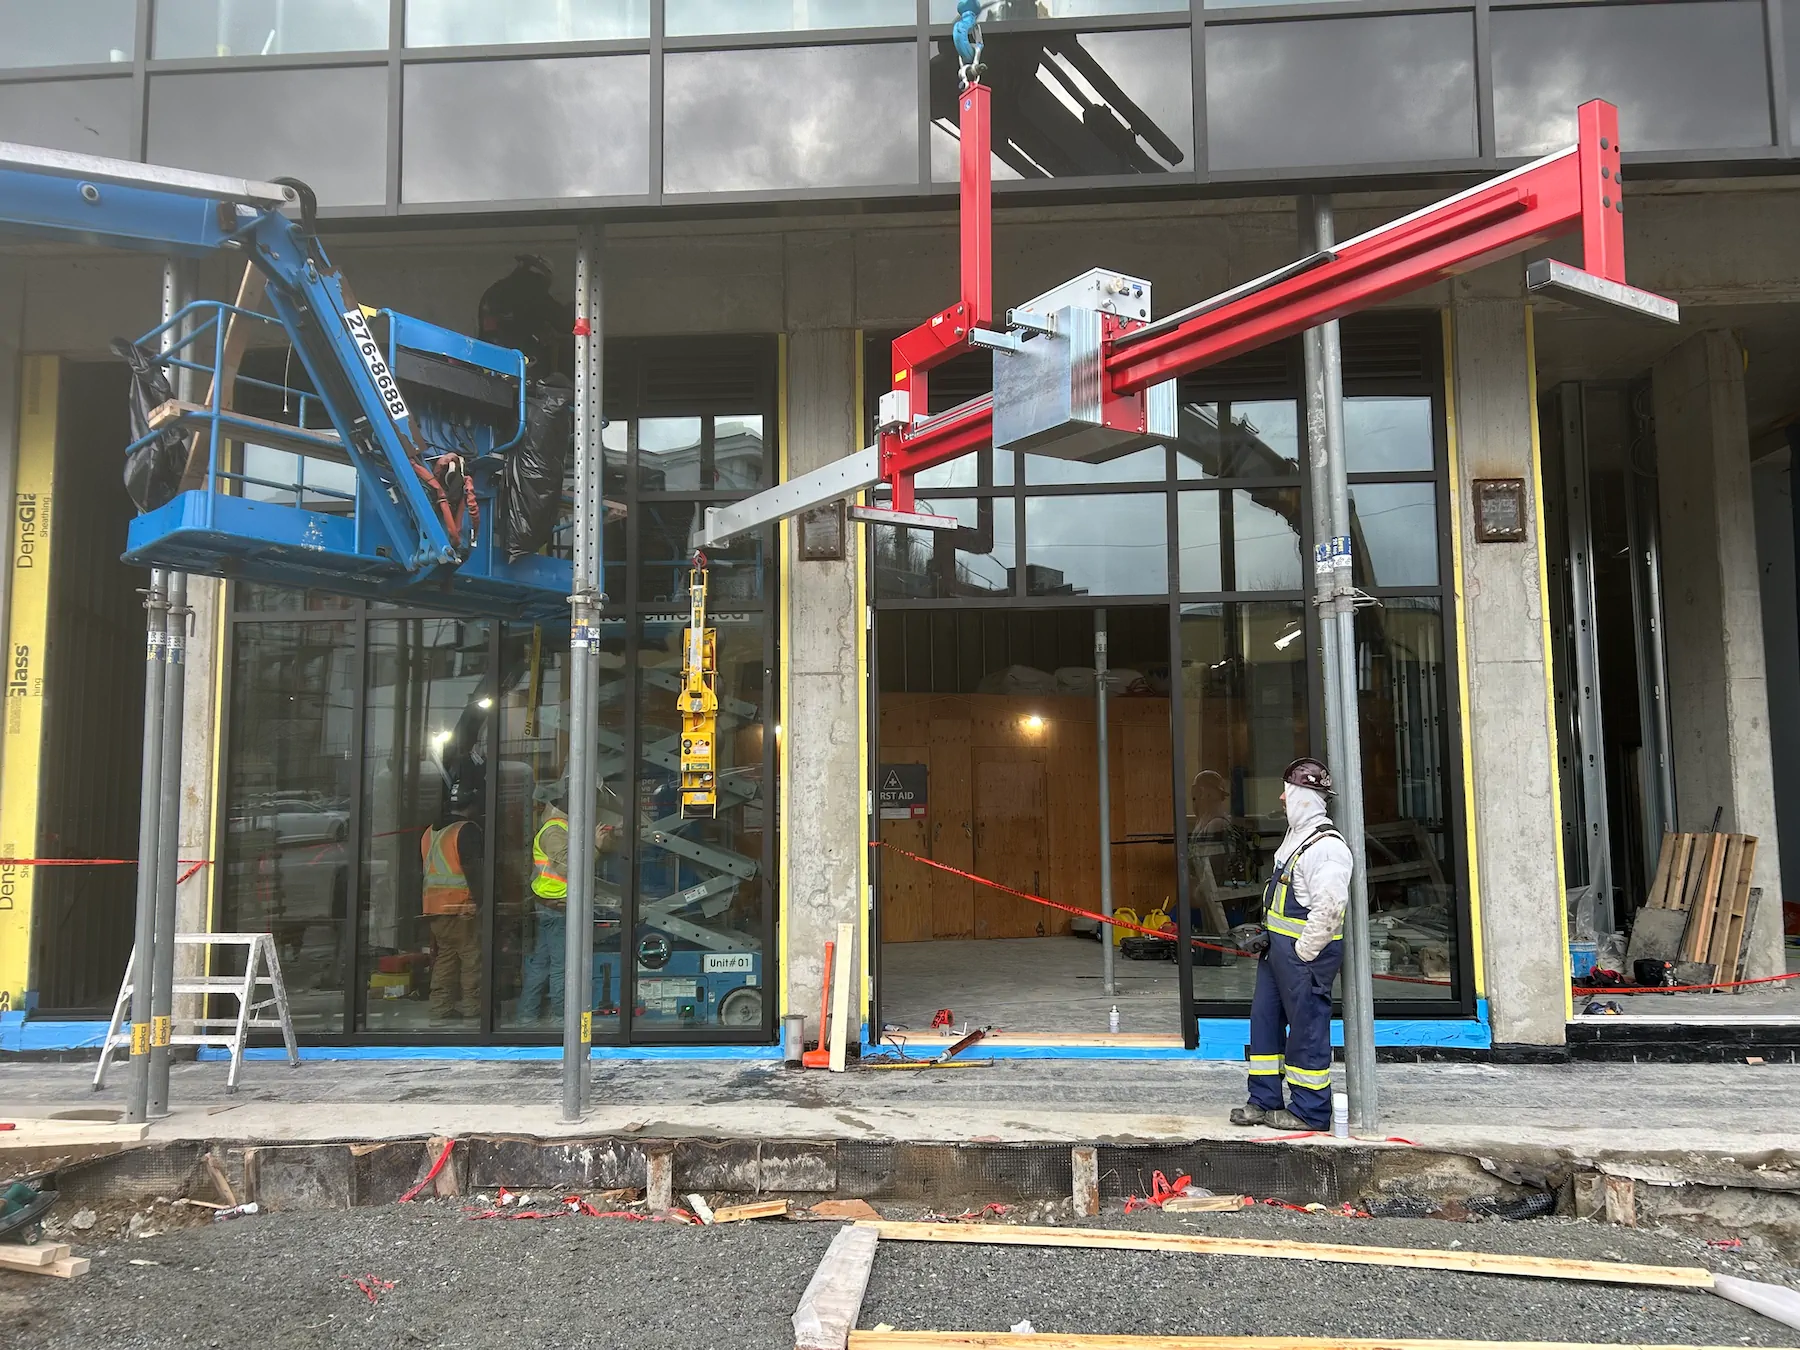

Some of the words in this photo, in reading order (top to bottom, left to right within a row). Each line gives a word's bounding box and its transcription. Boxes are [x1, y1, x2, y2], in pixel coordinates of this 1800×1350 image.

[346, 314, 405, 416] 276-8688
[39, 496, 51, 538] Sheathing
[898, 791, 914, 800] AID
